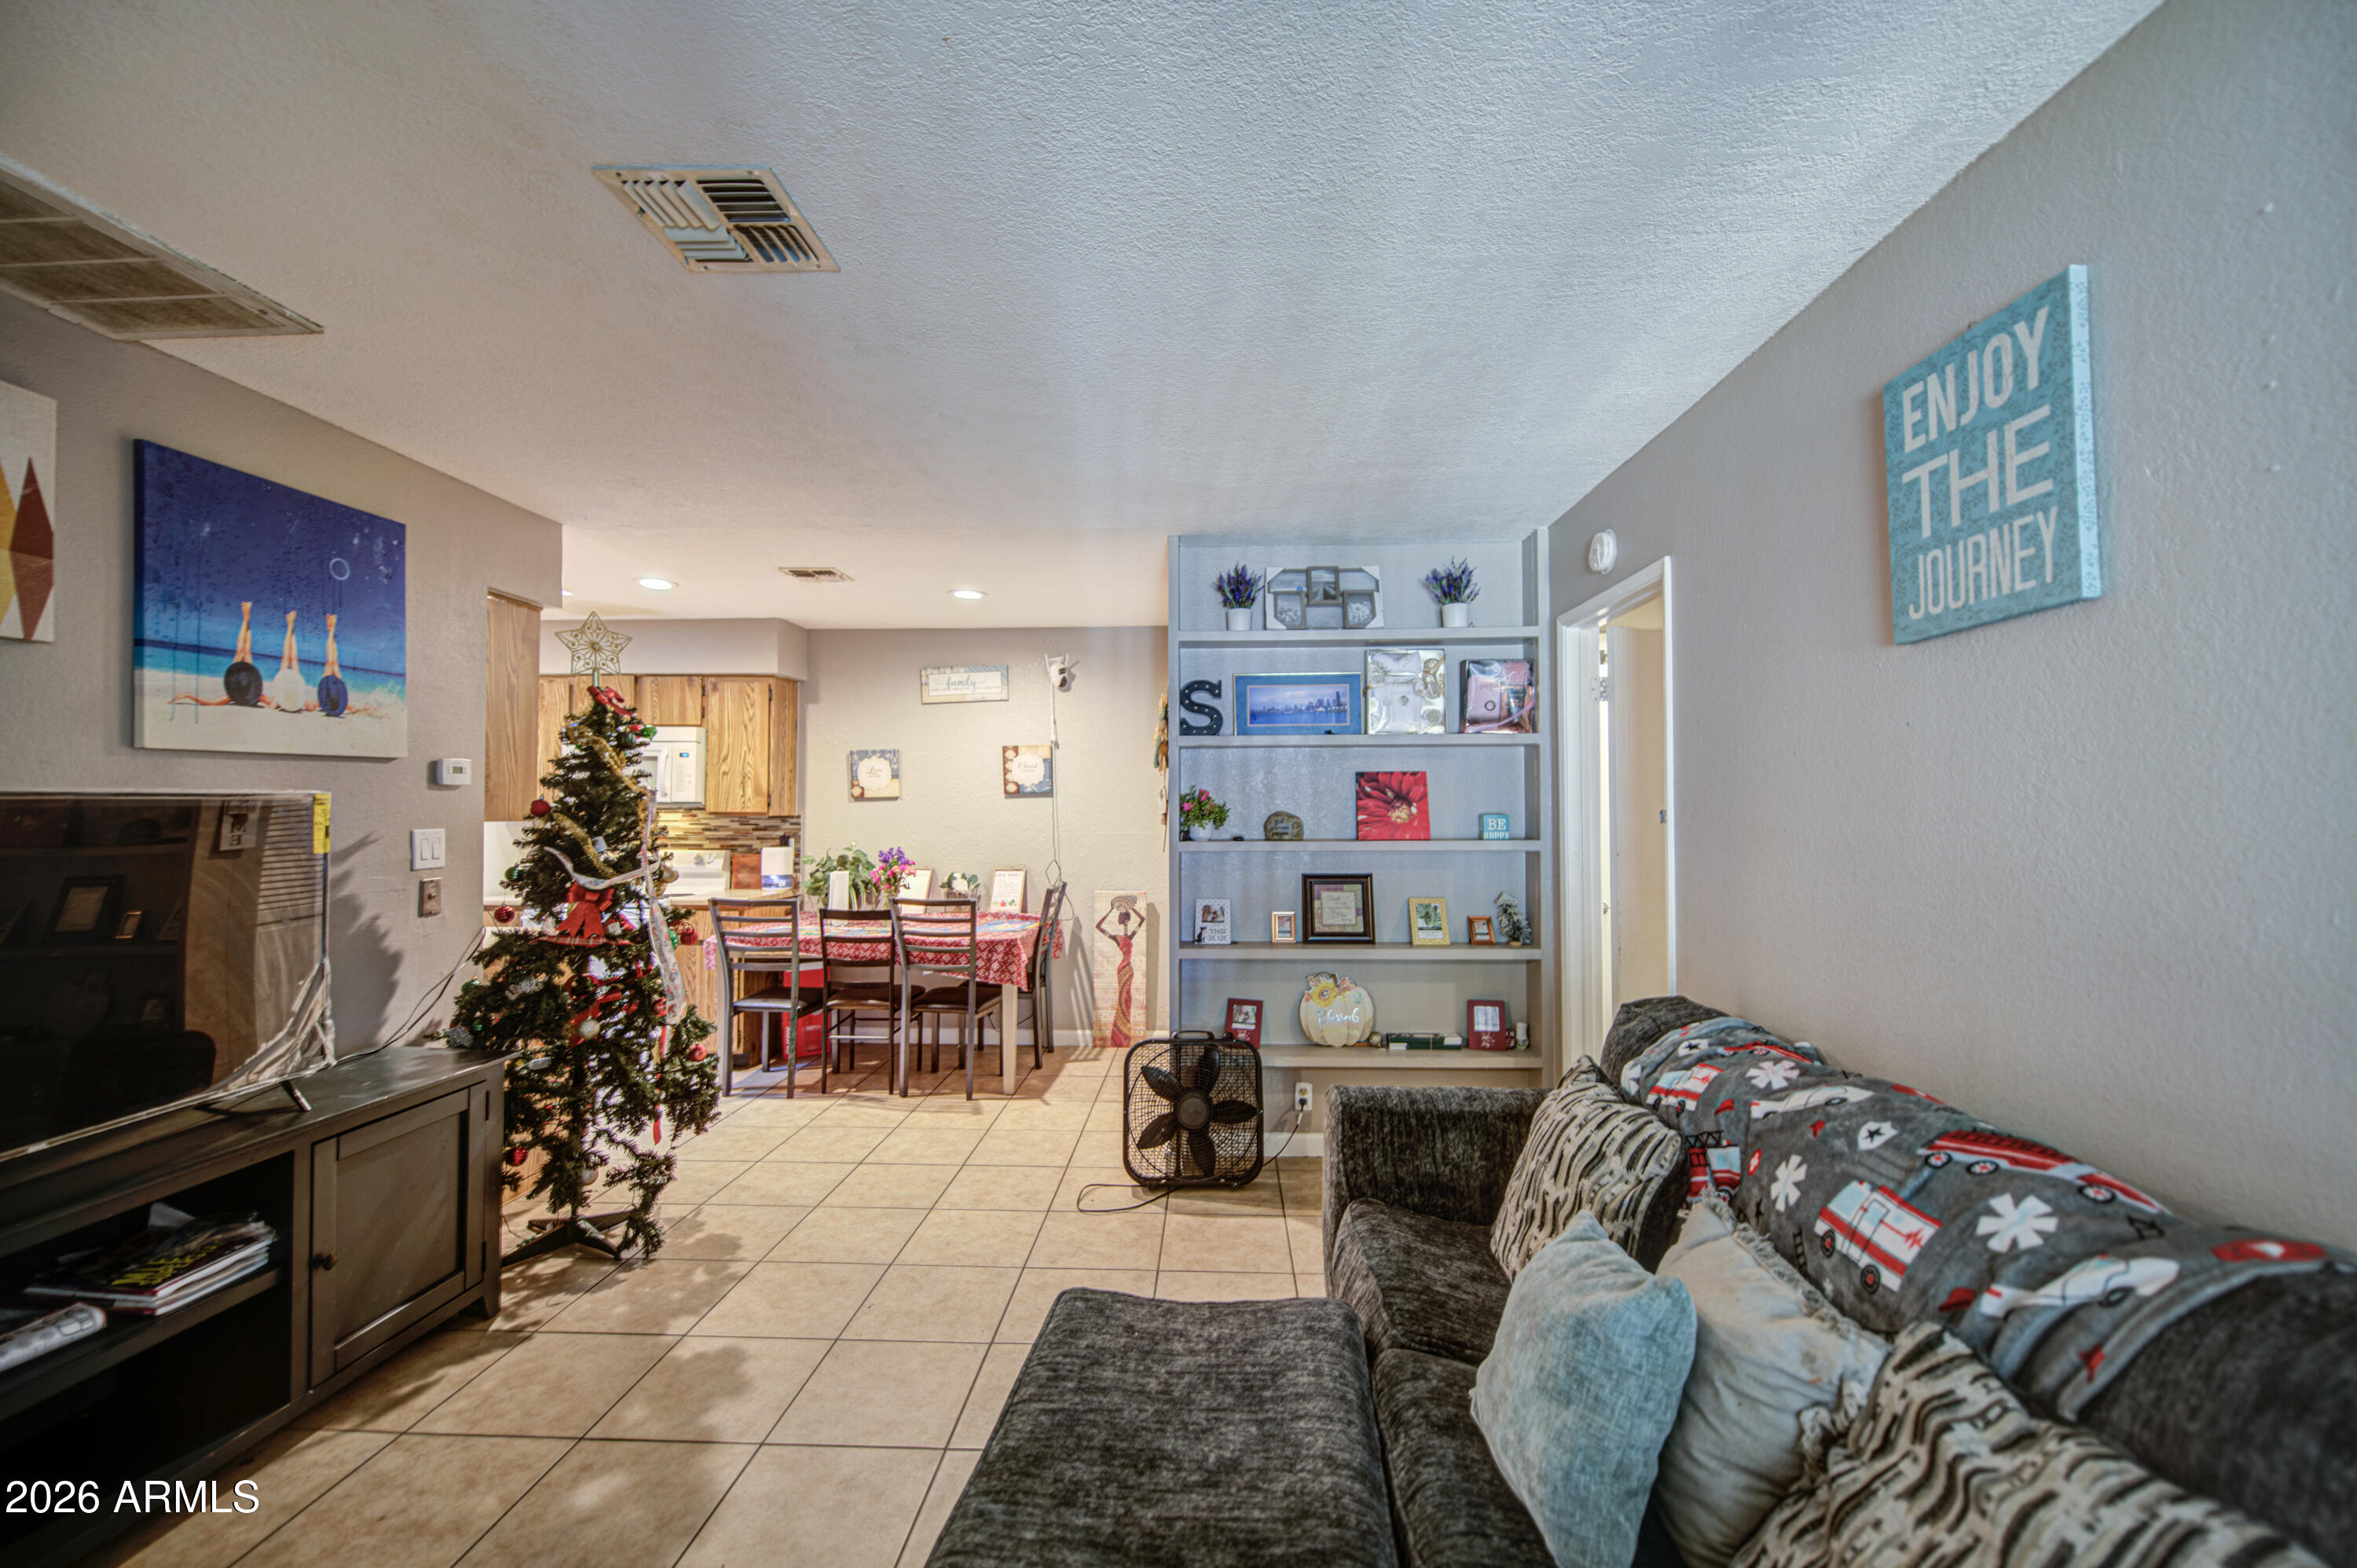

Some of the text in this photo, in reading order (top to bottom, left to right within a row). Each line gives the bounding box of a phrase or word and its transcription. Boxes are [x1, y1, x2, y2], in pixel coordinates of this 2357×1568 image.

[1902, 306, 2049, 453] ENJOY
[1902, 405, 2055, 540] THE
[1909, 506, 2058, 619] JOURNEY
[947, 674, 976, 692] family
[1180, 680, 1223, 735] S
[1486, 818, 1506, 830] BE
[1316, 1008, 1360, 1029] Blessed
